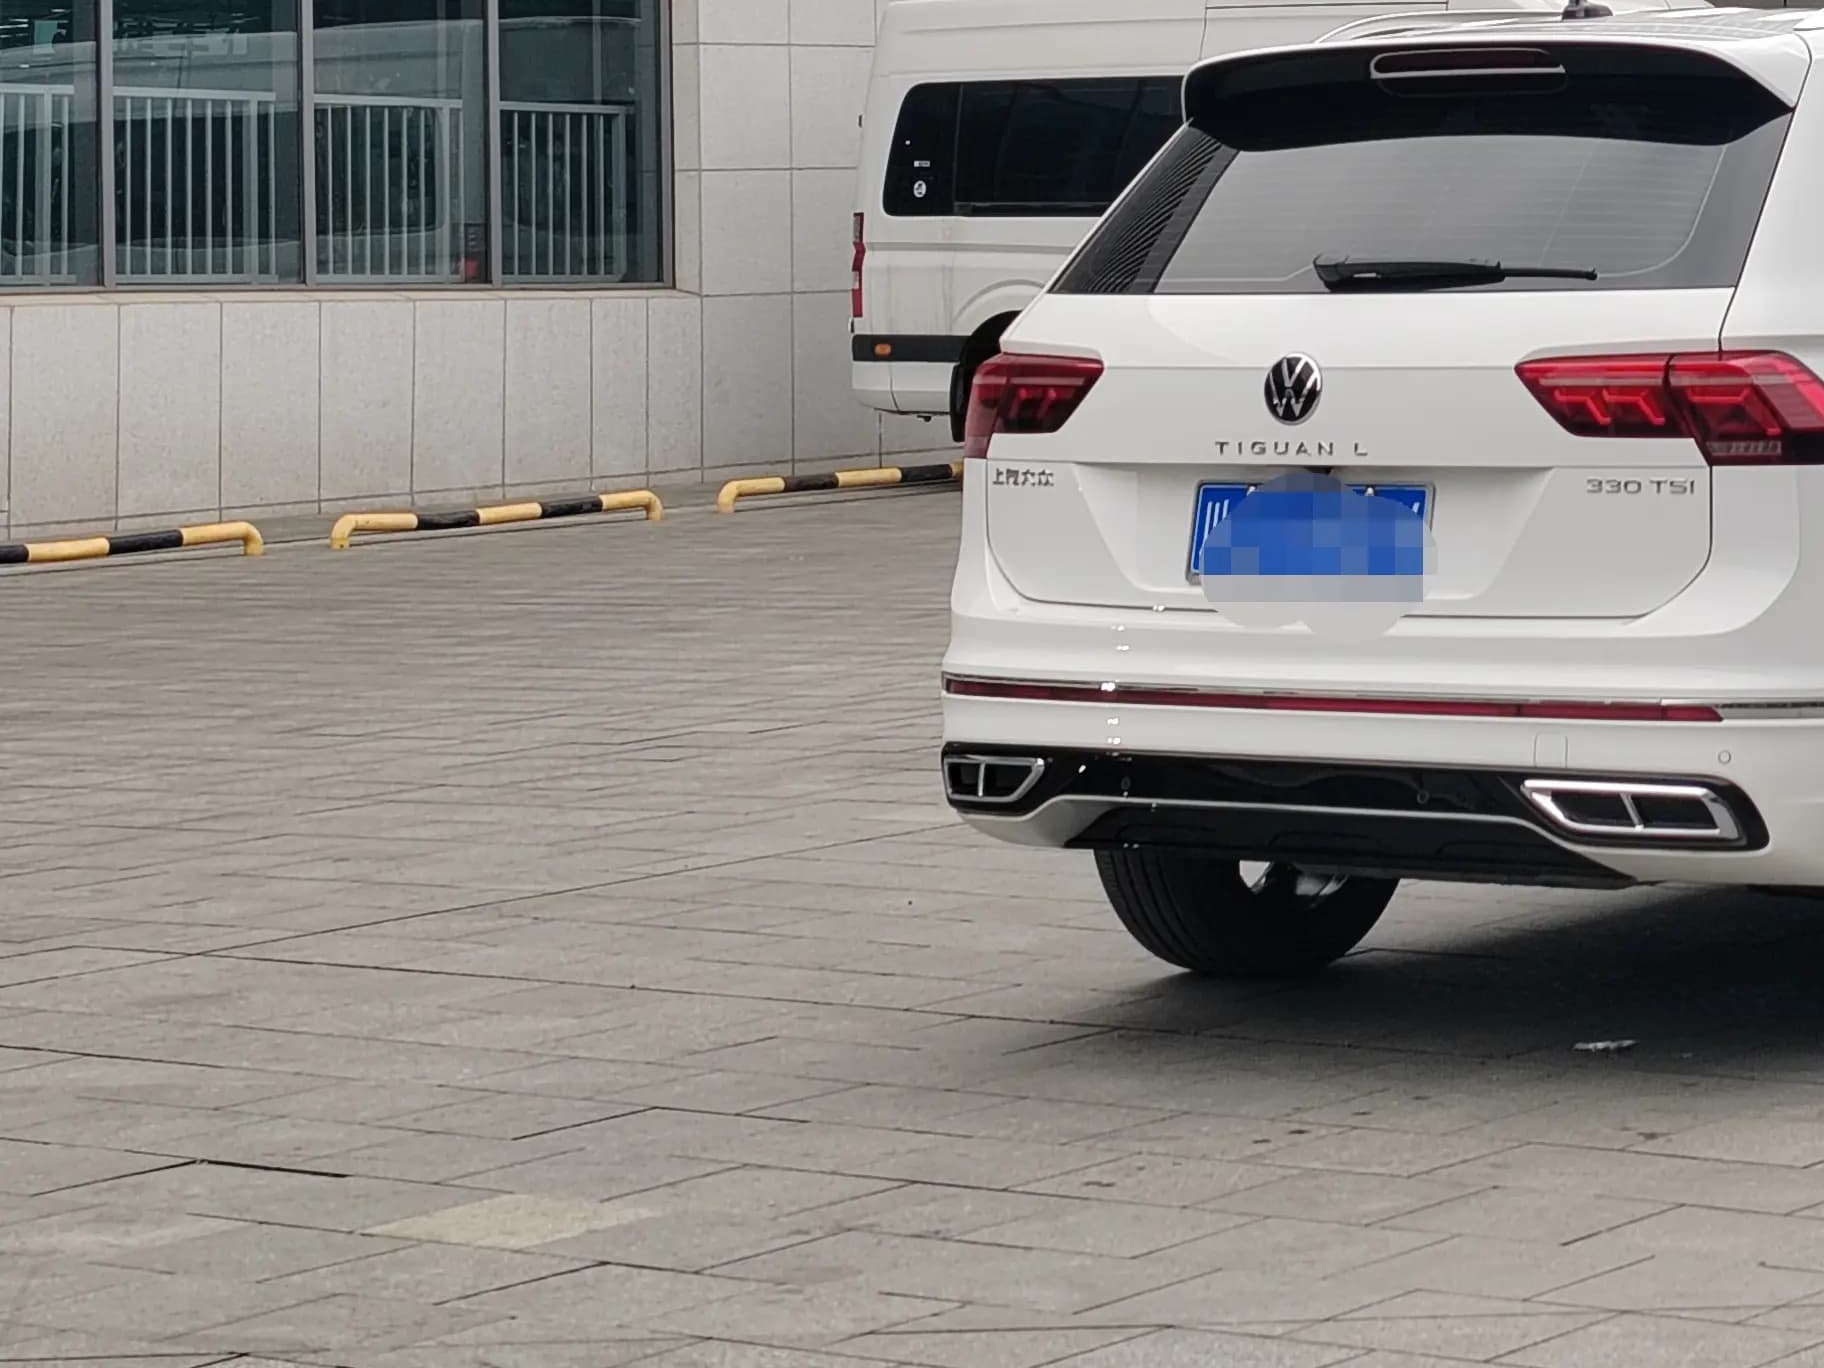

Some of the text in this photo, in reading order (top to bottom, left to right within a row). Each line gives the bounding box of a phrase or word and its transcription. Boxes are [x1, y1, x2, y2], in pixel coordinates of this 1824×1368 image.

[1215, 441, 1368, 457] TIGUAN L
[1586, 479, 1695, 494] 330 TSI
